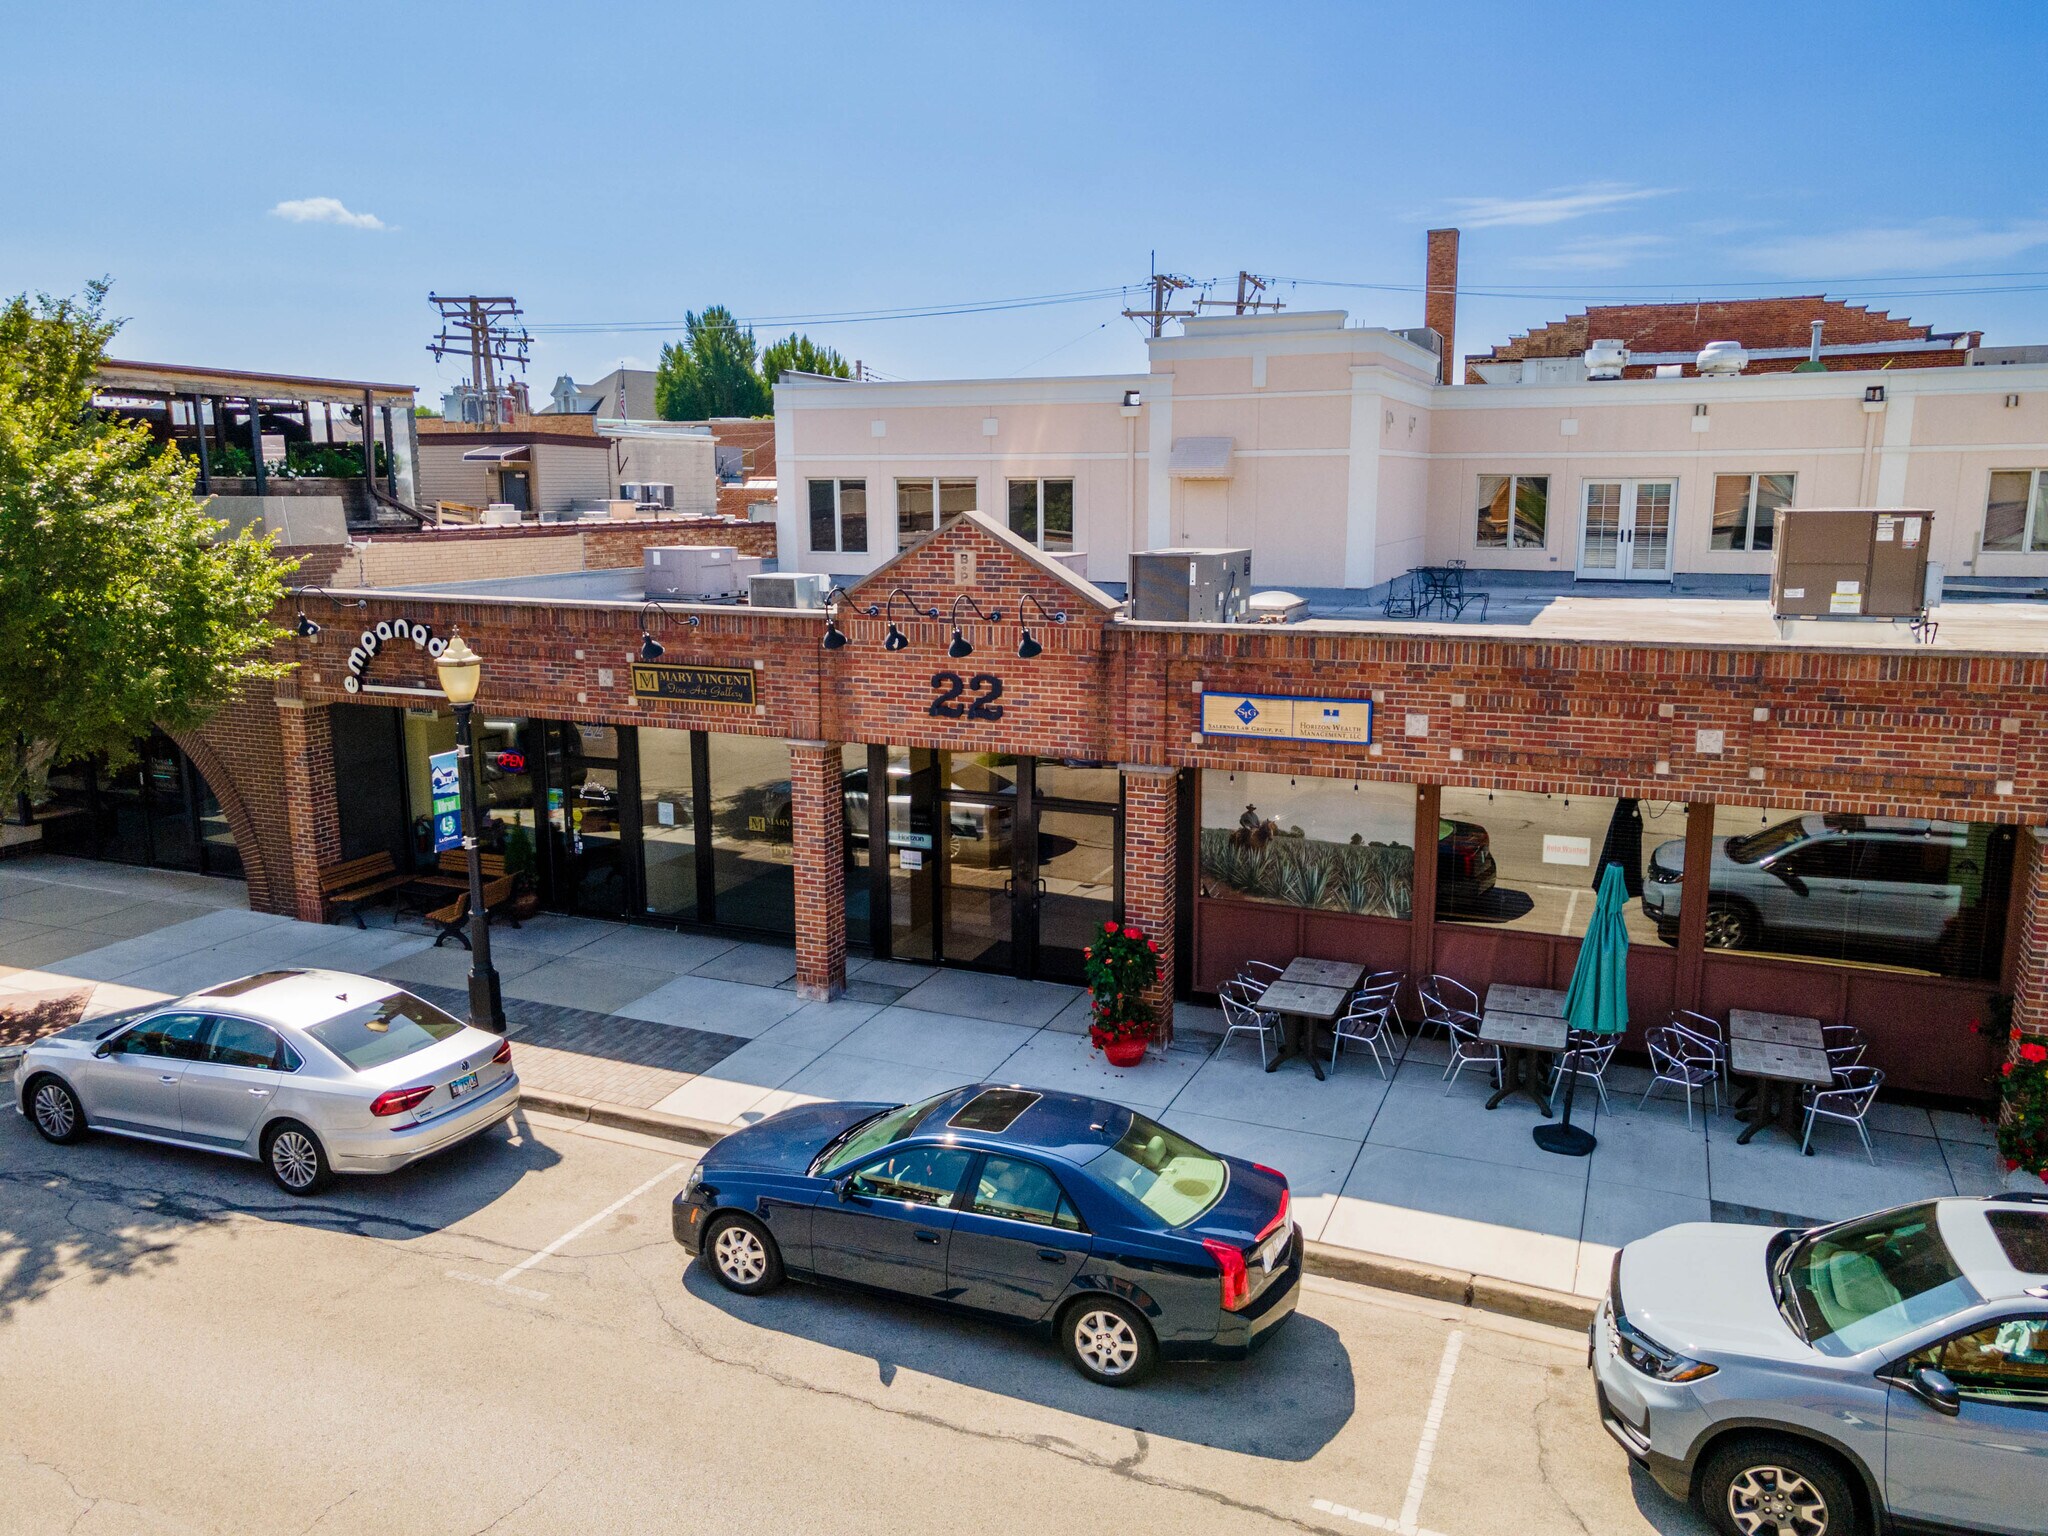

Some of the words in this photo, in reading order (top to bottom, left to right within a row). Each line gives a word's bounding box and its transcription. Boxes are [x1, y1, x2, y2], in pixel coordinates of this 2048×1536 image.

[344, 619, 448, 694] empanad
[660, 671, 693, 683] MARY
[696, 673, 749, 686] VINCENT
[667, 683, 686, 694] Fine
[690, 685, 707, 696] Art
[710, 685, 743, 701] Gallery
[928, 672, 1004, 721] 22
[583, 722, 604, 739] 22
[497, 753, 525, 768] OPEN
[766, 817, 790, 827] MARY
